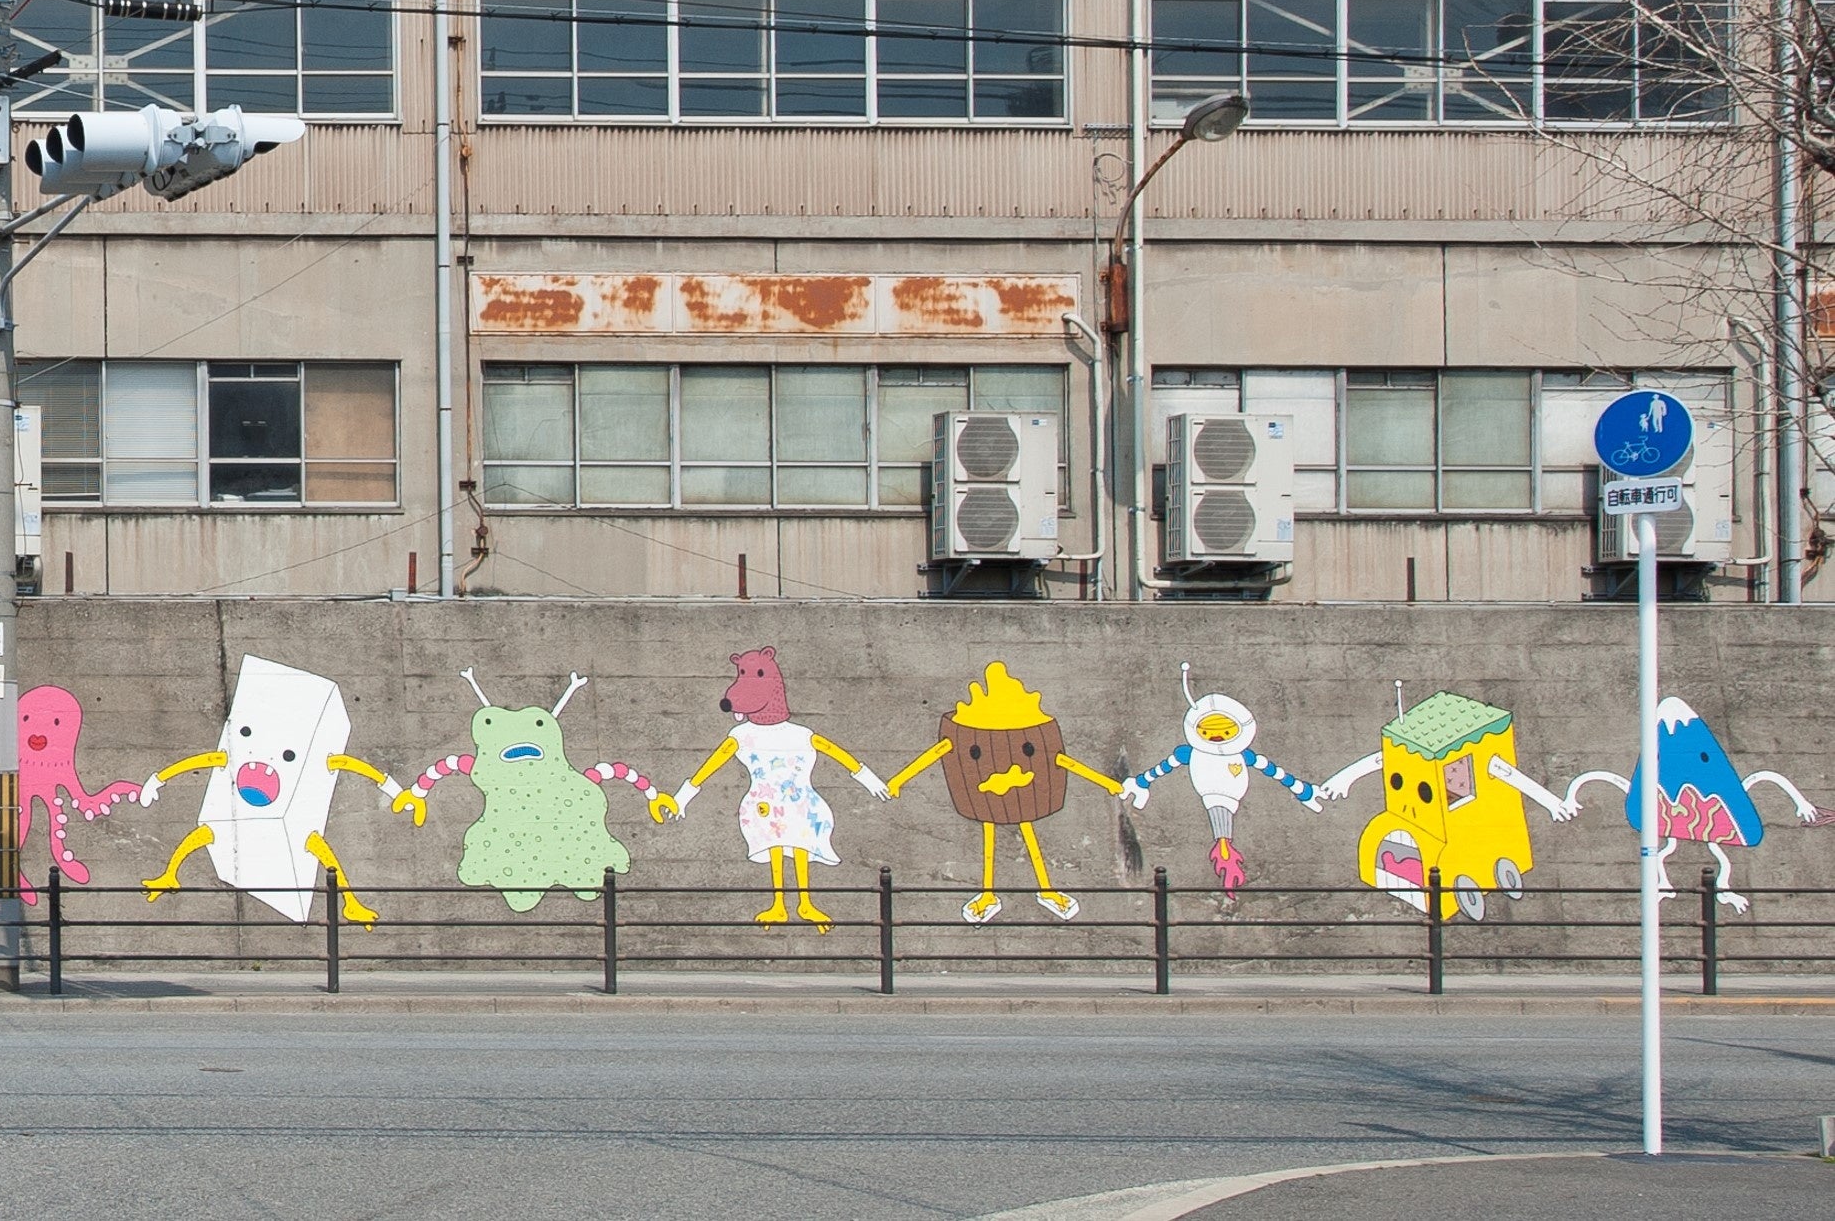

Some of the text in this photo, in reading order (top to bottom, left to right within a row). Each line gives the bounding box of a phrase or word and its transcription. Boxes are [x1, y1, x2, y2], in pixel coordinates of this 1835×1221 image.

[1608, 485, 1677, 506] 自転車通行可
